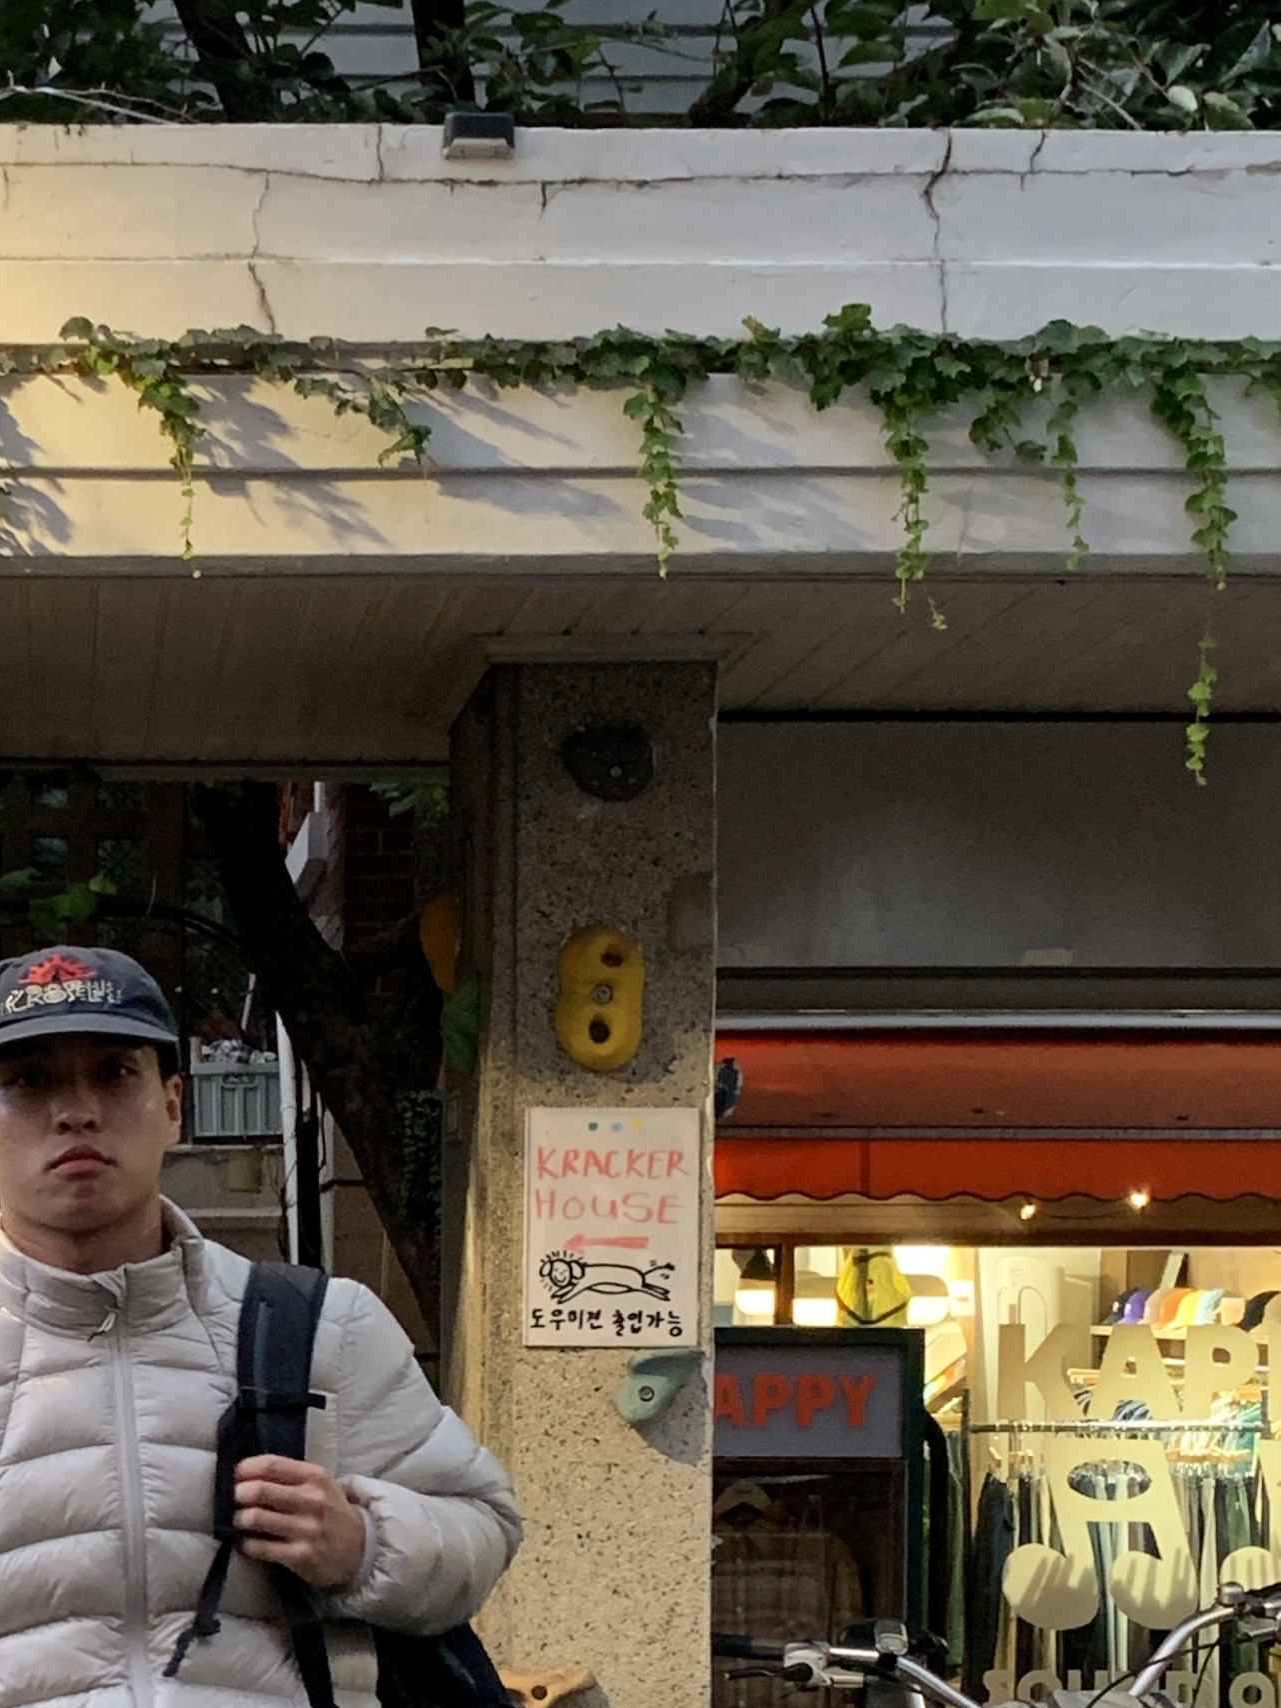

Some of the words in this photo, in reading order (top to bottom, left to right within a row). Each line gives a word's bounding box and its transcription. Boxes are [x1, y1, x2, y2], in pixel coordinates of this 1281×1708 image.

[536, 1145, 689, 1180] KRACKER
[534, 1189, 684, 1225] HOUSE
[530, 1308, 603, 1331] 도우미견
[612, 1308, 683, 1337] 출입가능
